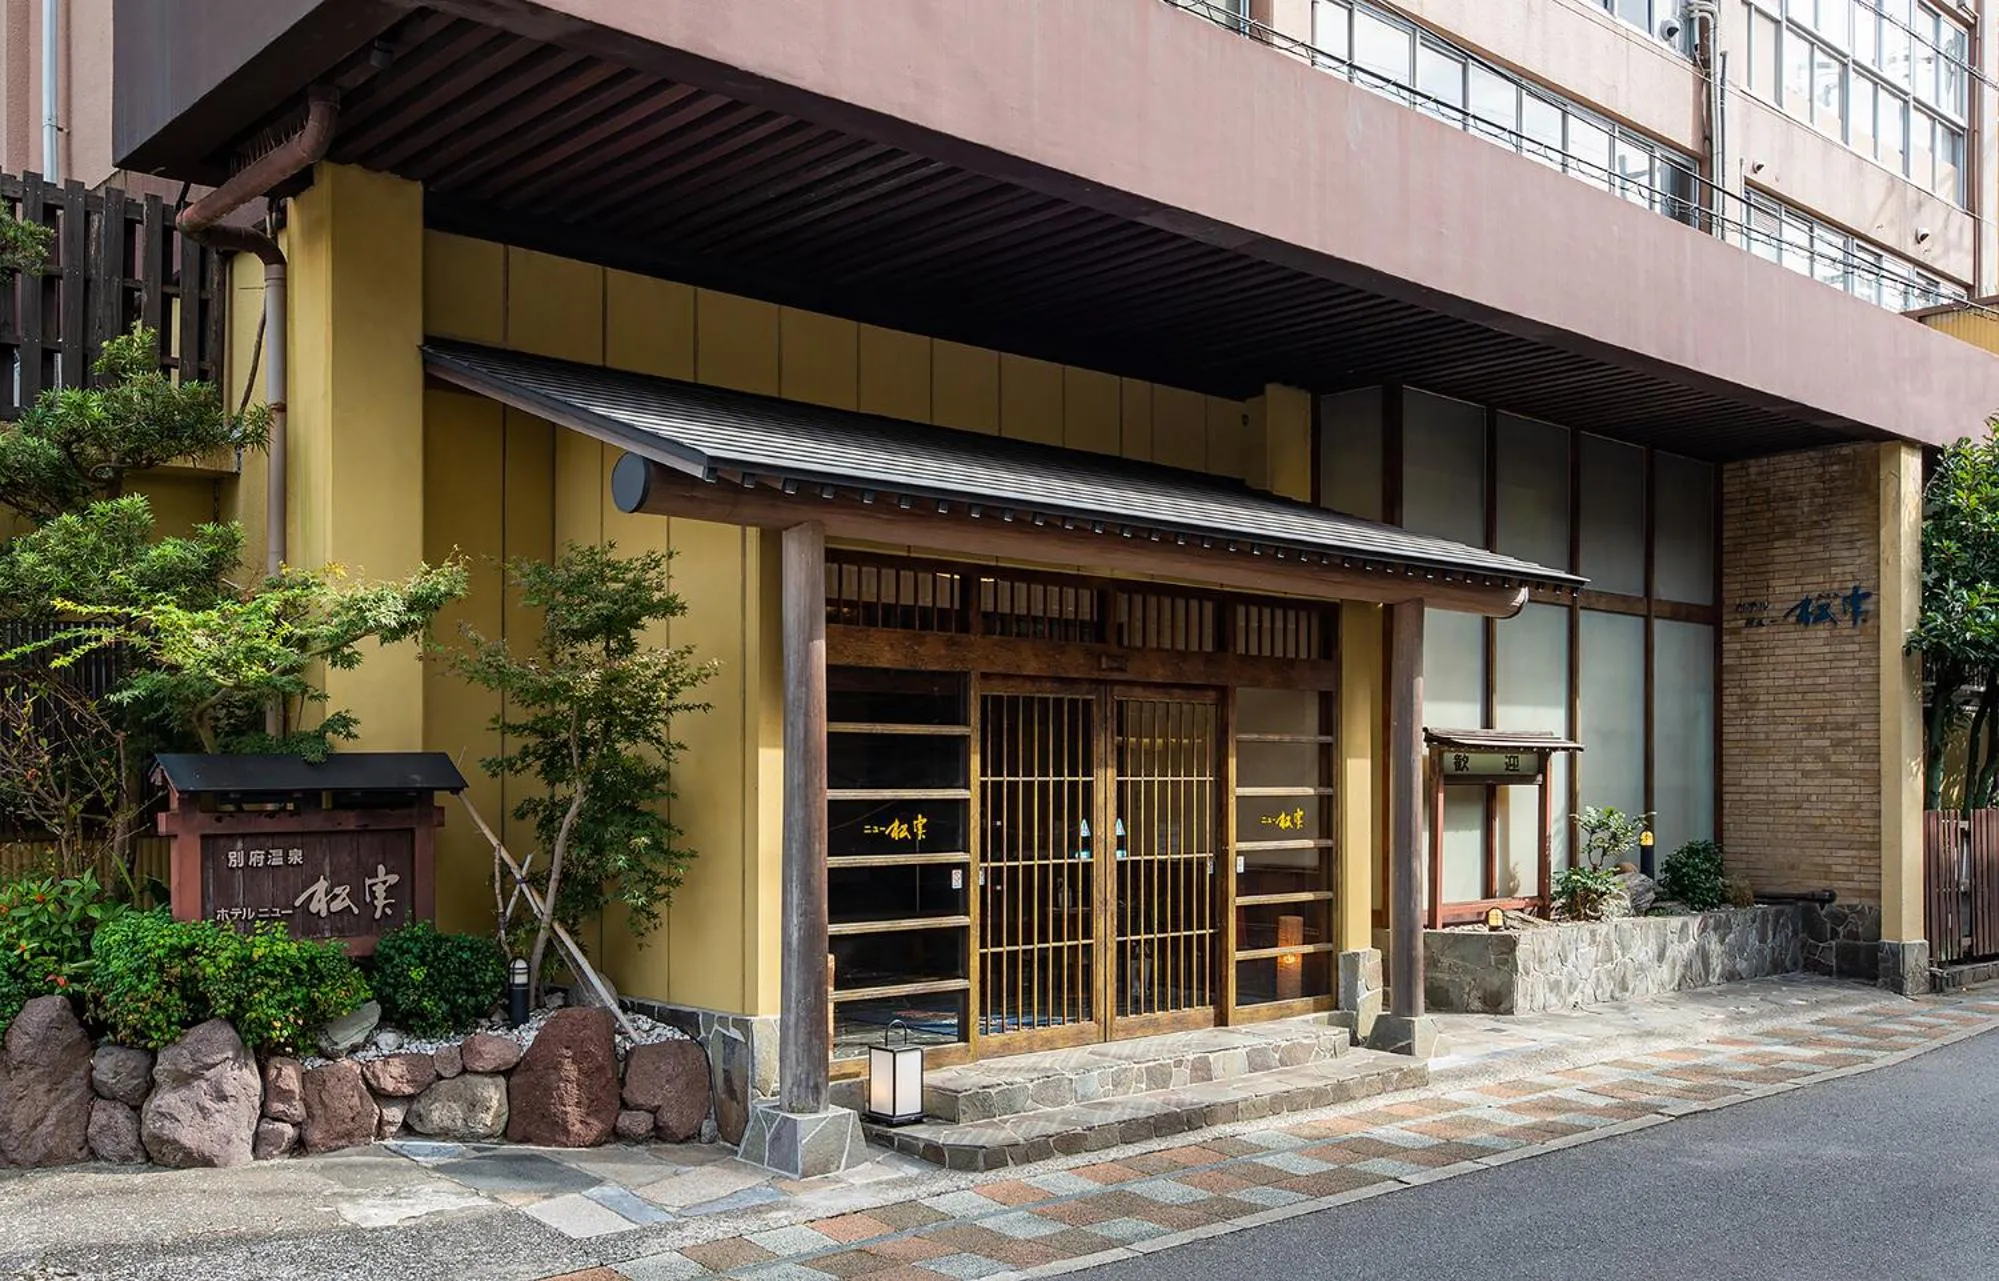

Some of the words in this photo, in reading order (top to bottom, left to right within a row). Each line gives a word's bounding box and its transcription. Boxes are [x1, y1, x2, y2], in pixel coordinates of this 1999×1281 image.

[227, 848, 304, 868] 別府温泉
[216, 906, 294, 922] ホテルニュー
[294, 863, 400, 920] 松実
